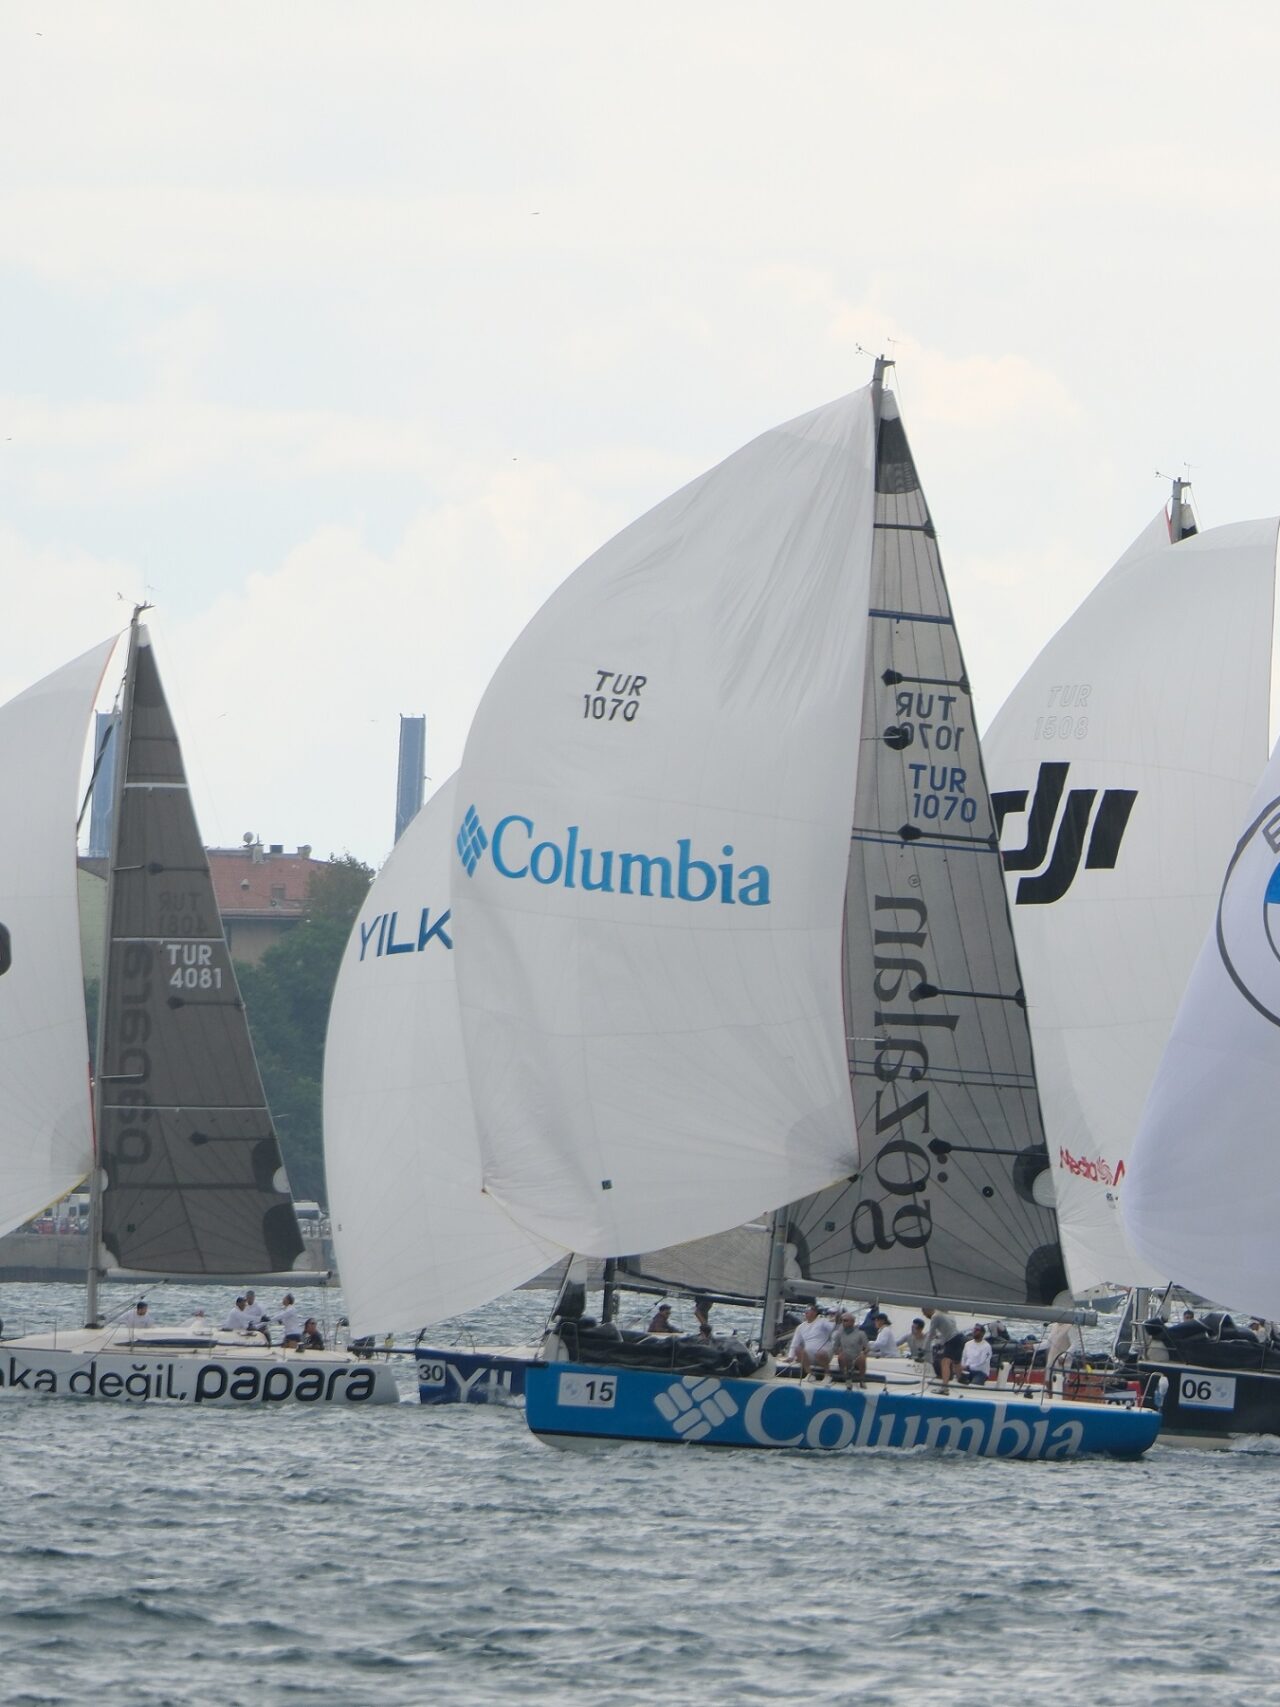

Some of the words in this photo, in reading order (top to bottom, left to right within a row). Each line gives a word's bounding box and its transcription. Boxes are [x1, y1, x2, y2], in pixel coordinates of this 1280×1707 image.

[595, 669, 648, 696] TUR
[583, 694, 640, 722] 1070
[908, 763, 967, 793] TUR
[913, 793, 978, 823] 1070
[491, 814, 771, 906] Columbia
[359, 907, 453, 961] YILK
[166, 944, 213, 966] TUR
[169, 967, 222, 989] 4081
[0, 1356, 57, 1393] ka
[194, 1364, 376, 1402] papara
[419, 1365, 443, 1382] 30
[586, 1381, 614, 1402] 15
[1182, 1379, 1212, 1400] 06
[744, 1384, 1084, 1460] Columbia
